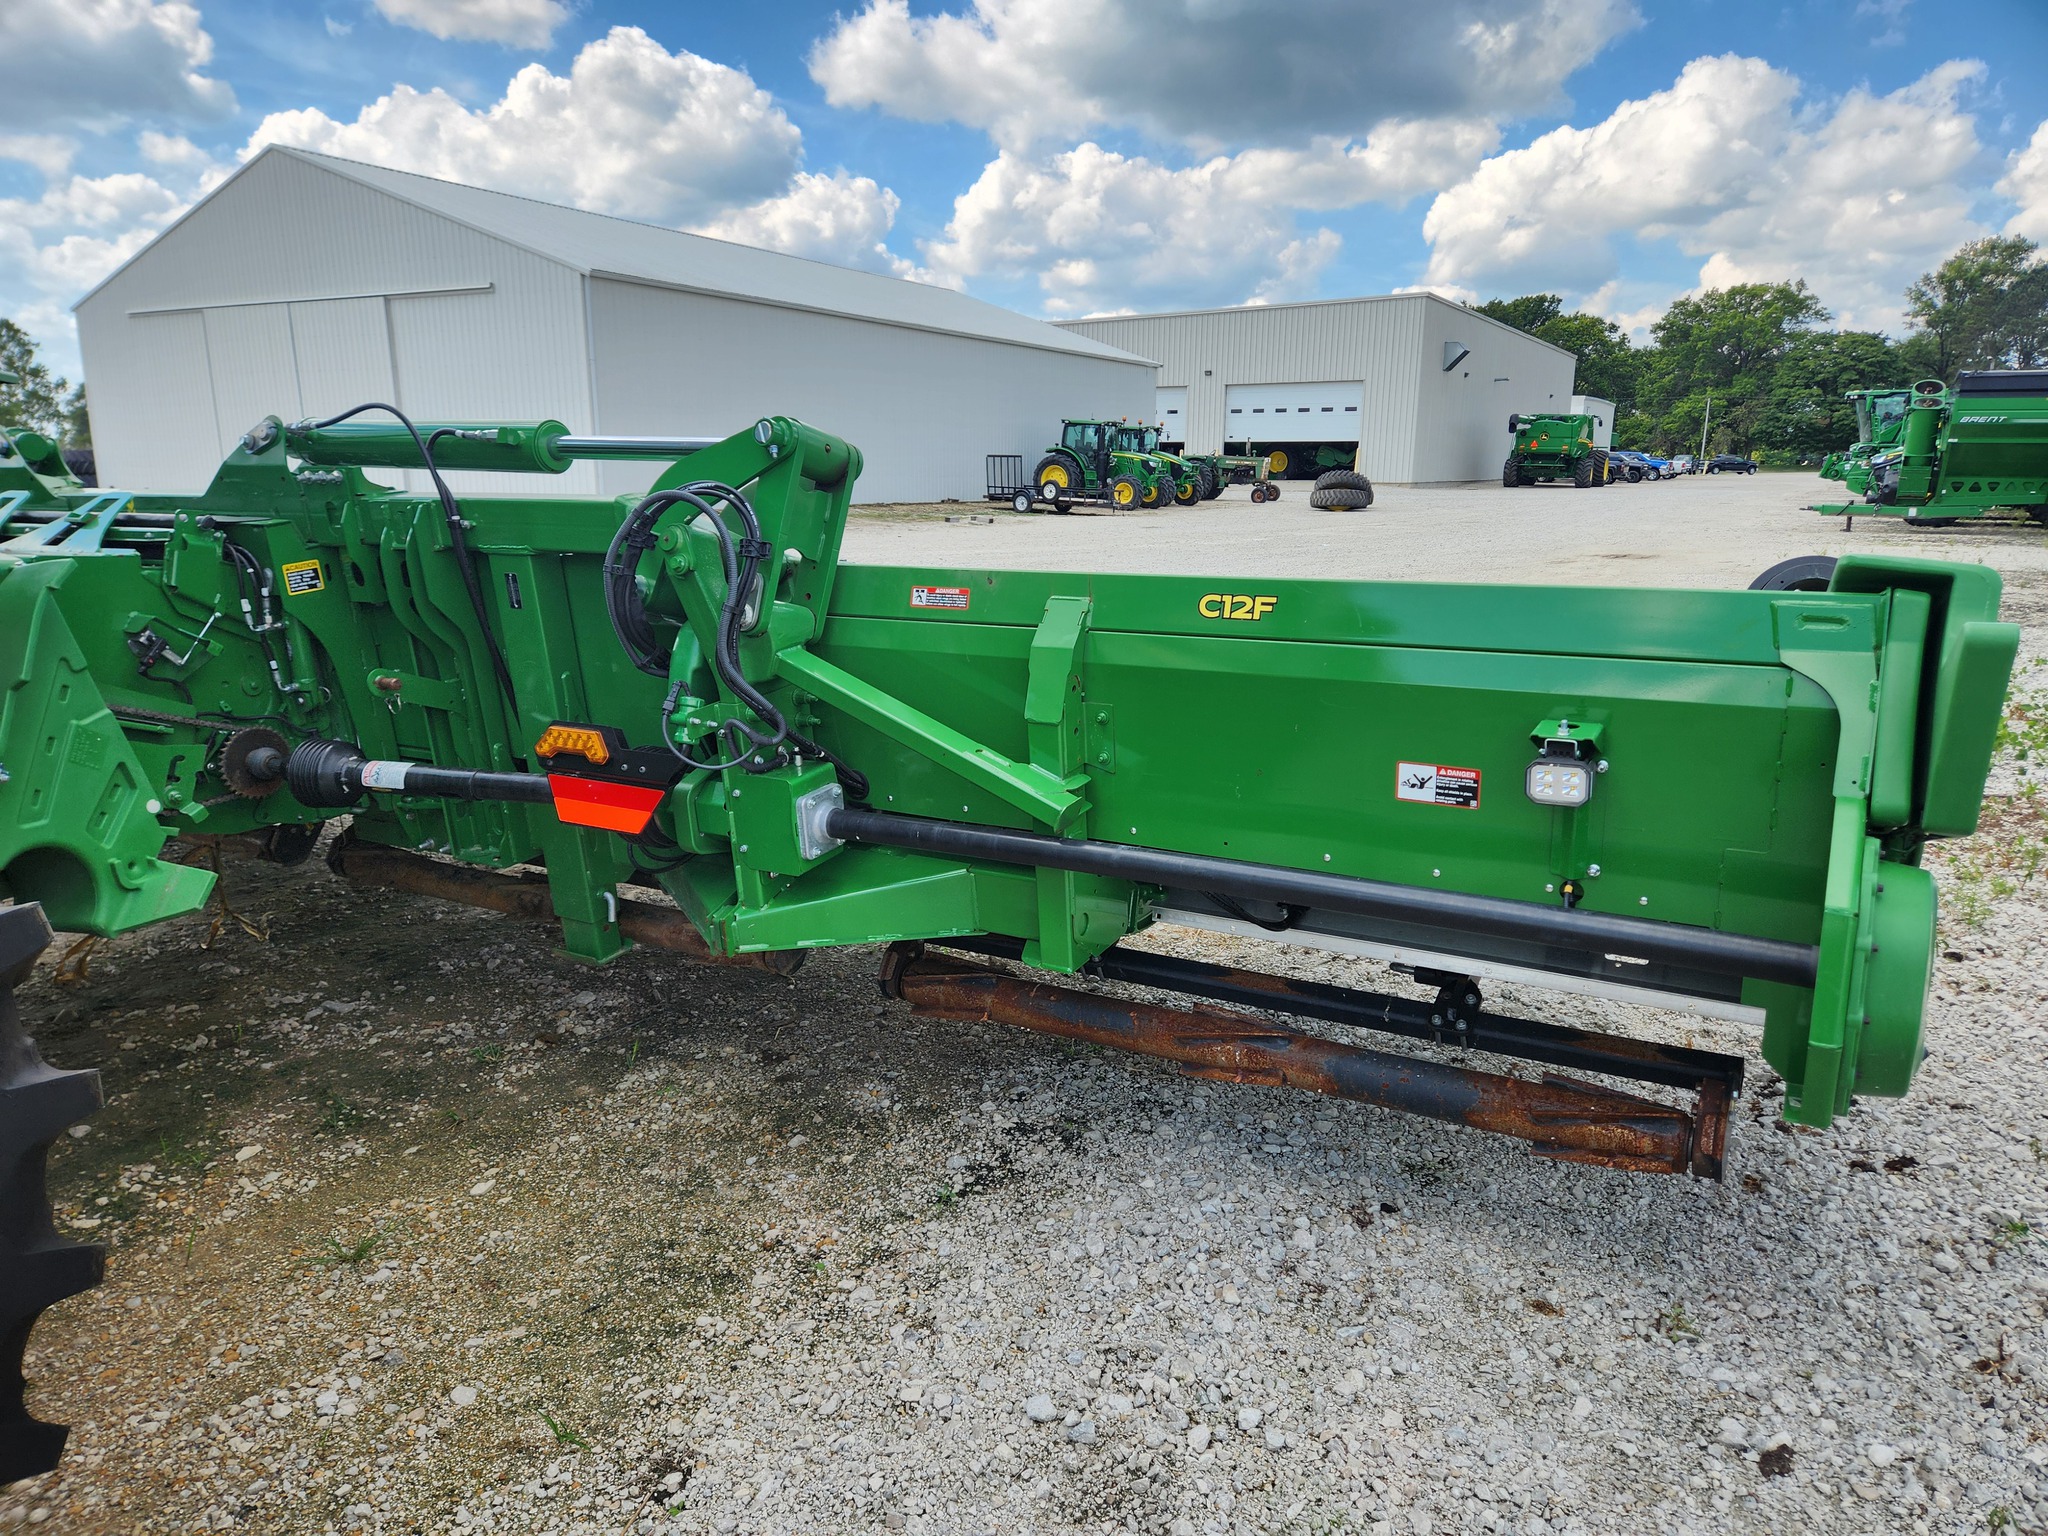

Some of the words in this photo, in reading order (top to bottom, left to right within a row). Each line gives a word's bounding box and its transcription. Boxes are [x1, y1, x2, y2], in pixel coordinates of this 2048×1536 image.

[290, 562, 318, 570] CAUTION
[1198, 593, 1278, 621] C12F
[1447, 770, 1476, 778] DANGER
